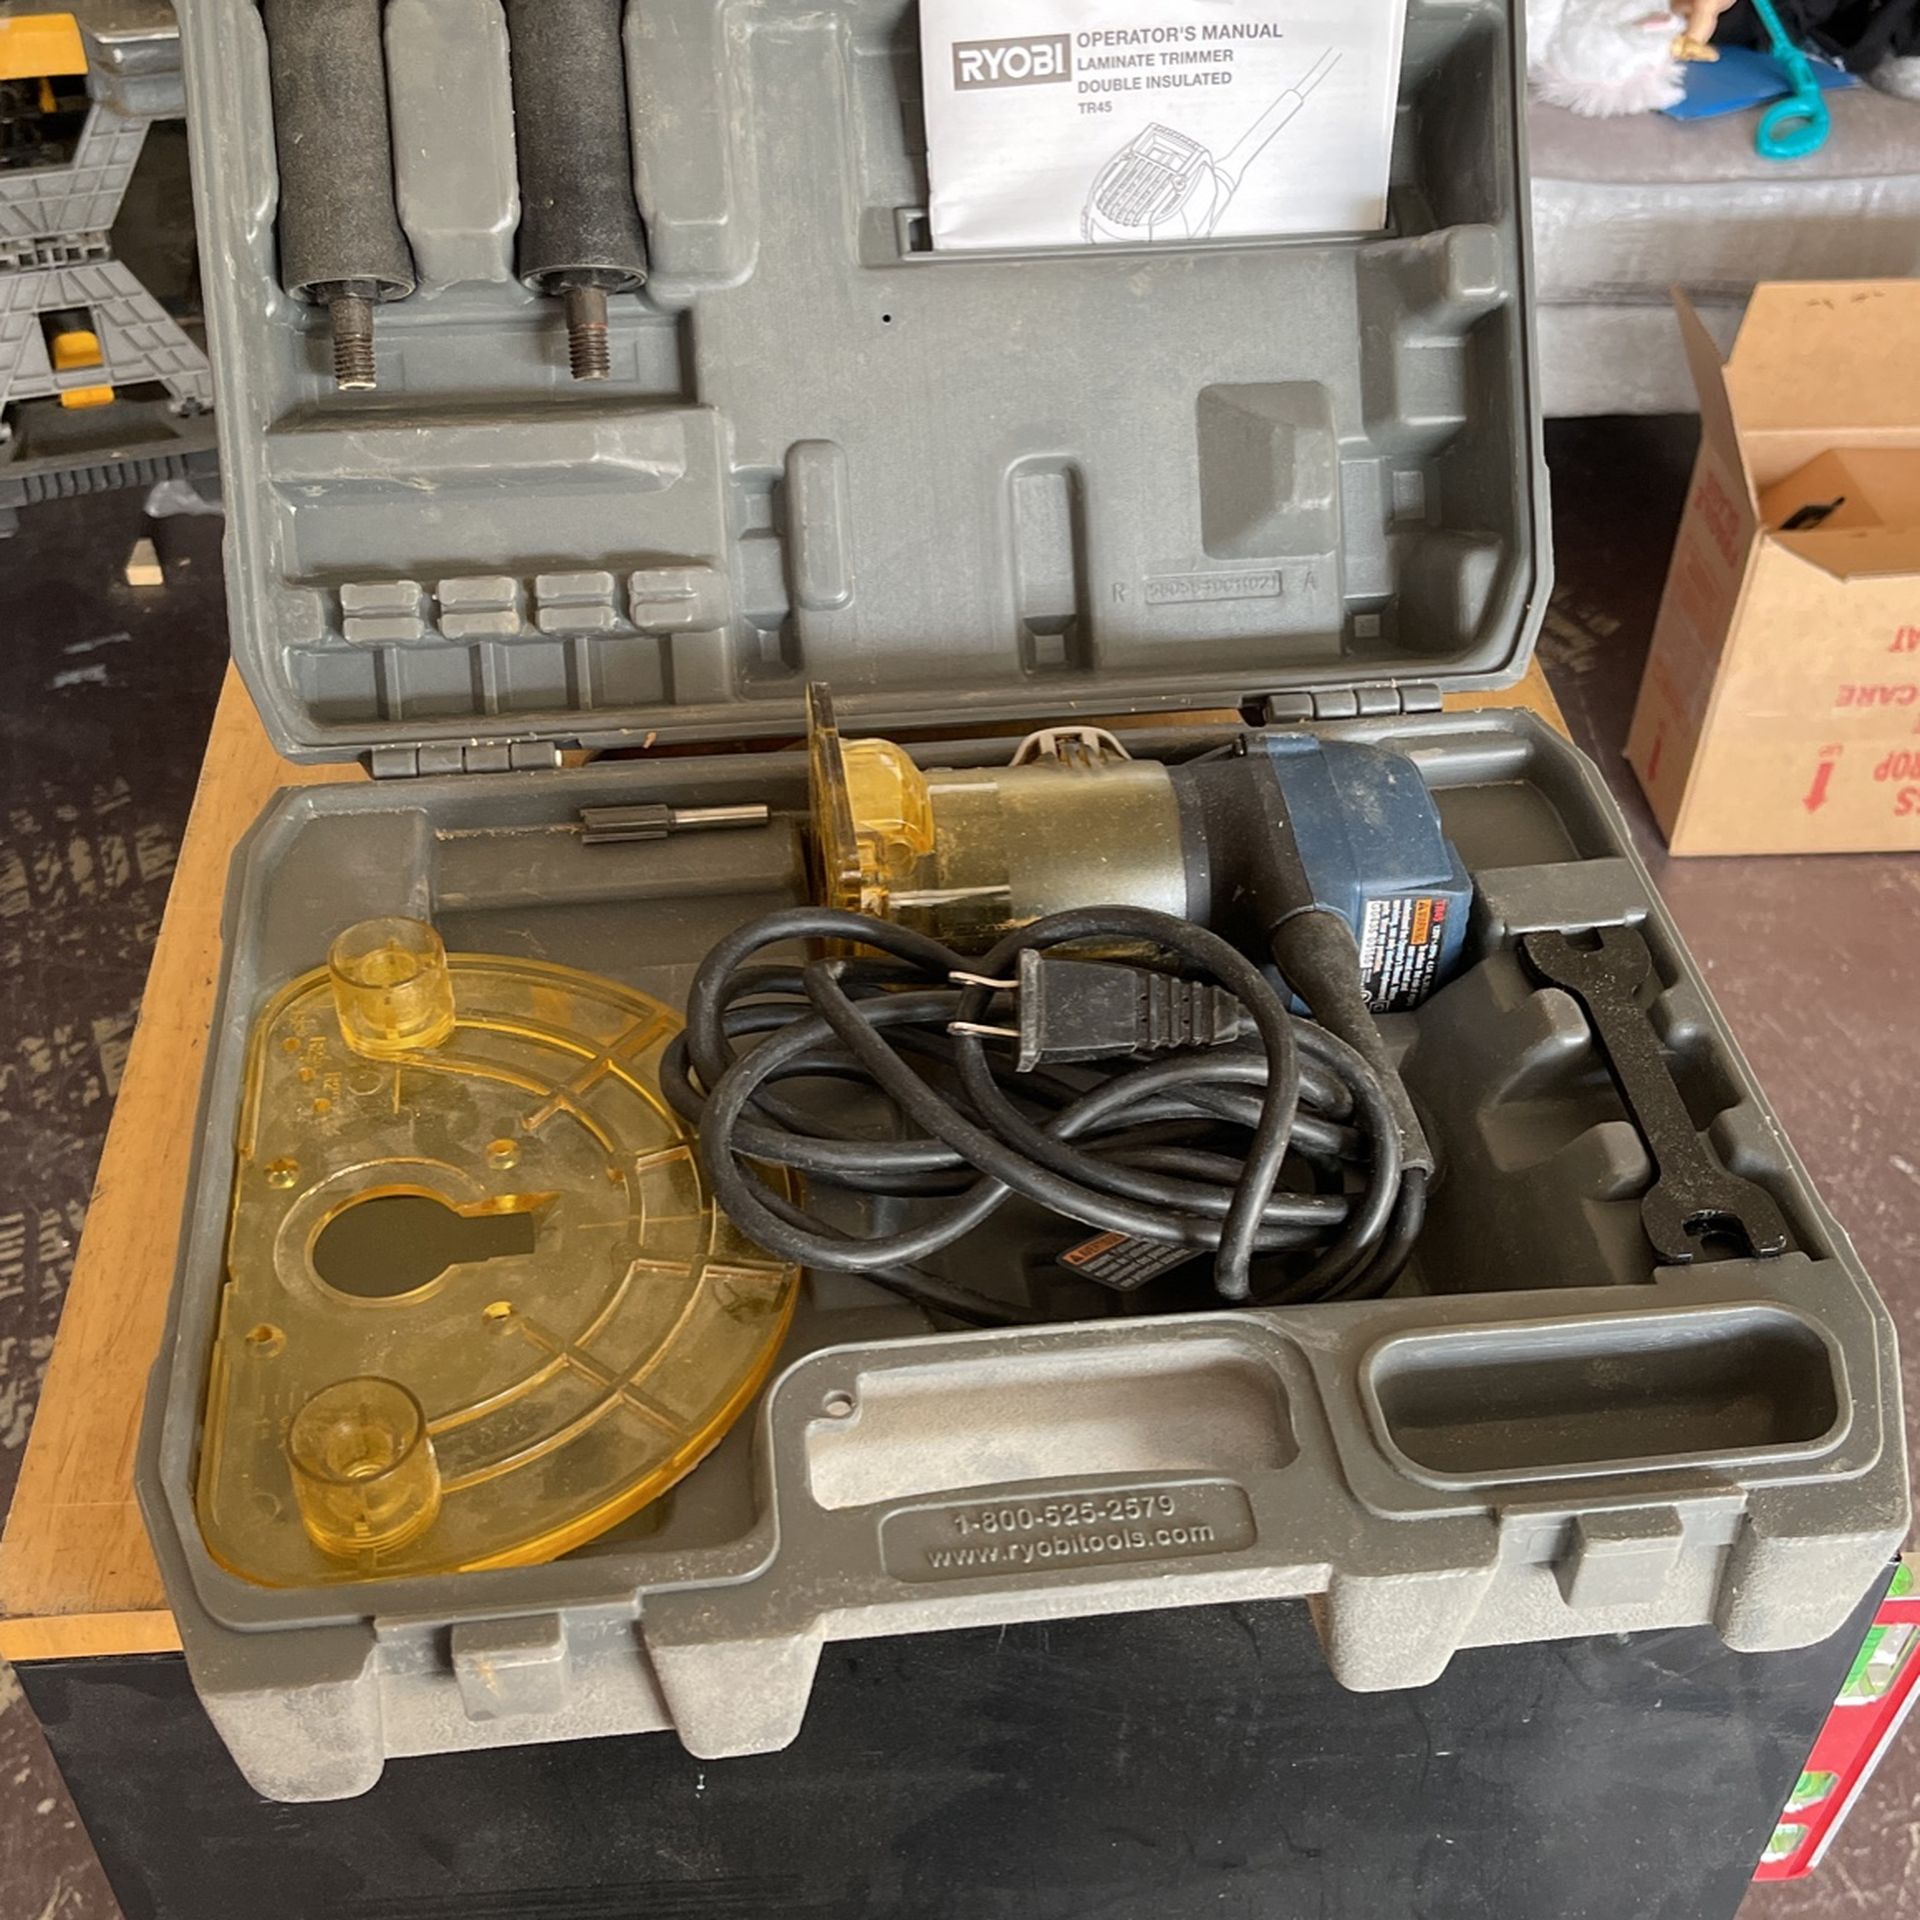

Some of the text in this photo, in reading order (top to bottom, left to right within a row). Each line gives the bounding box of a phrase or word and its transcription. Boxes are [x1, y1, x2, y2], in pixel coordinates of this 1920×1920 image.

[1077, 22, 1283, 48] OPERATOR'S MANUAL
[957, 42, 1066, 83] RYOBI
[1077, 48, 1234, 71] LAMINATE TRIMMER
[1077, 71, 1232, 94] DOUBLE INSULATED
[1078, 100, 1112, 115] TR45
[1836, 684, 1918, 708] CARE
[953, 1495, 1176, 1536] 1-800-525-2579
[927, 1523, 1215, 1568] www.ryobitools.com
